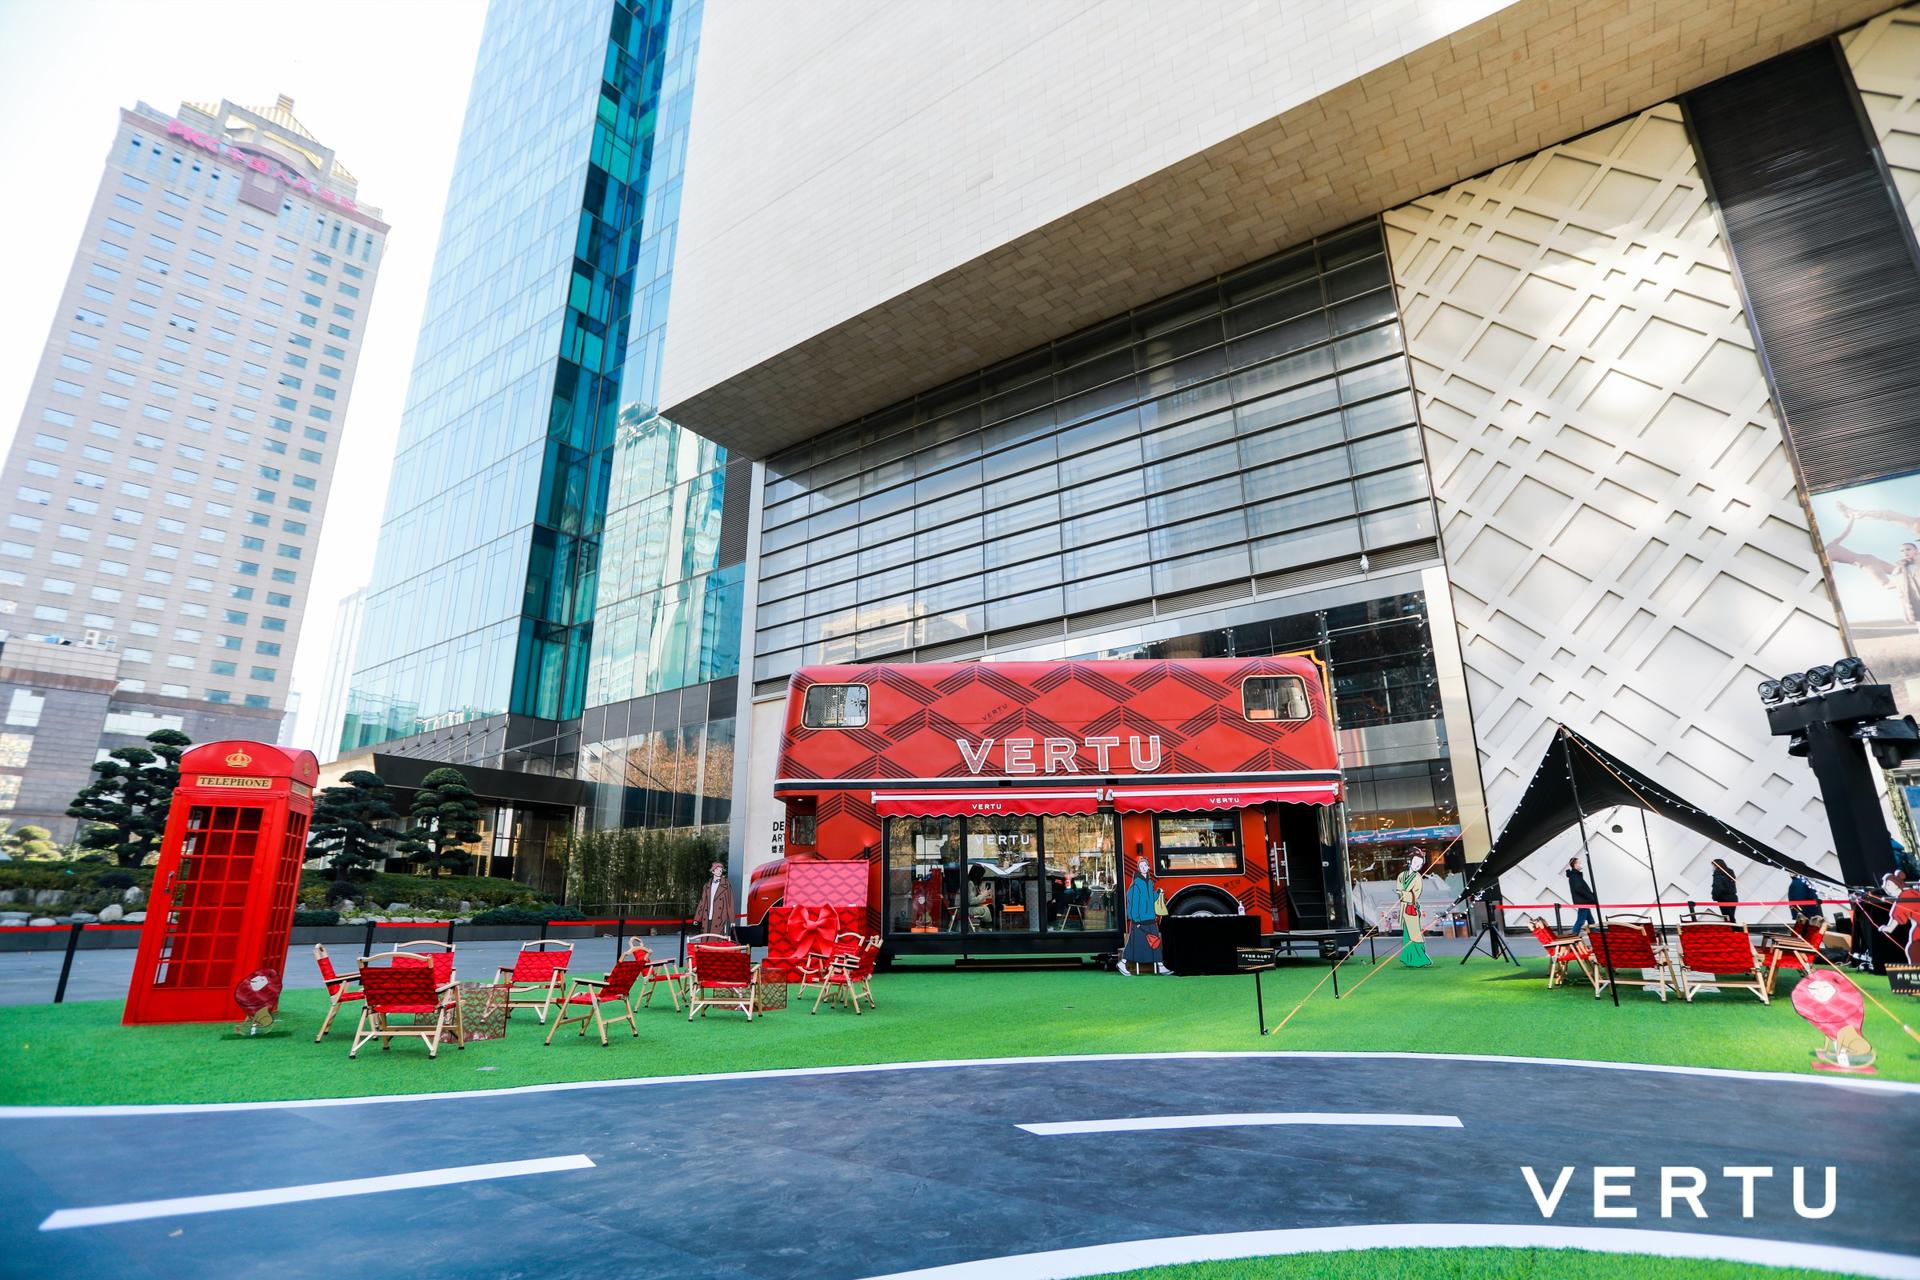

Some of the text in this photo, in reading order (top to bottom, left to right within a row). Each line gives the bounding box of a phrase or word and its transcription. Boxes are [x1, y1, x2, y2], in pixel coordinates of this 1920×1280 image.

[982, 703, 1008, 720] VERTU
[956, 736, 1161, 774] VERTU
[200, 777, 270, 787] TELEPHONE
[975, 834, 1030, 845] VERTU
